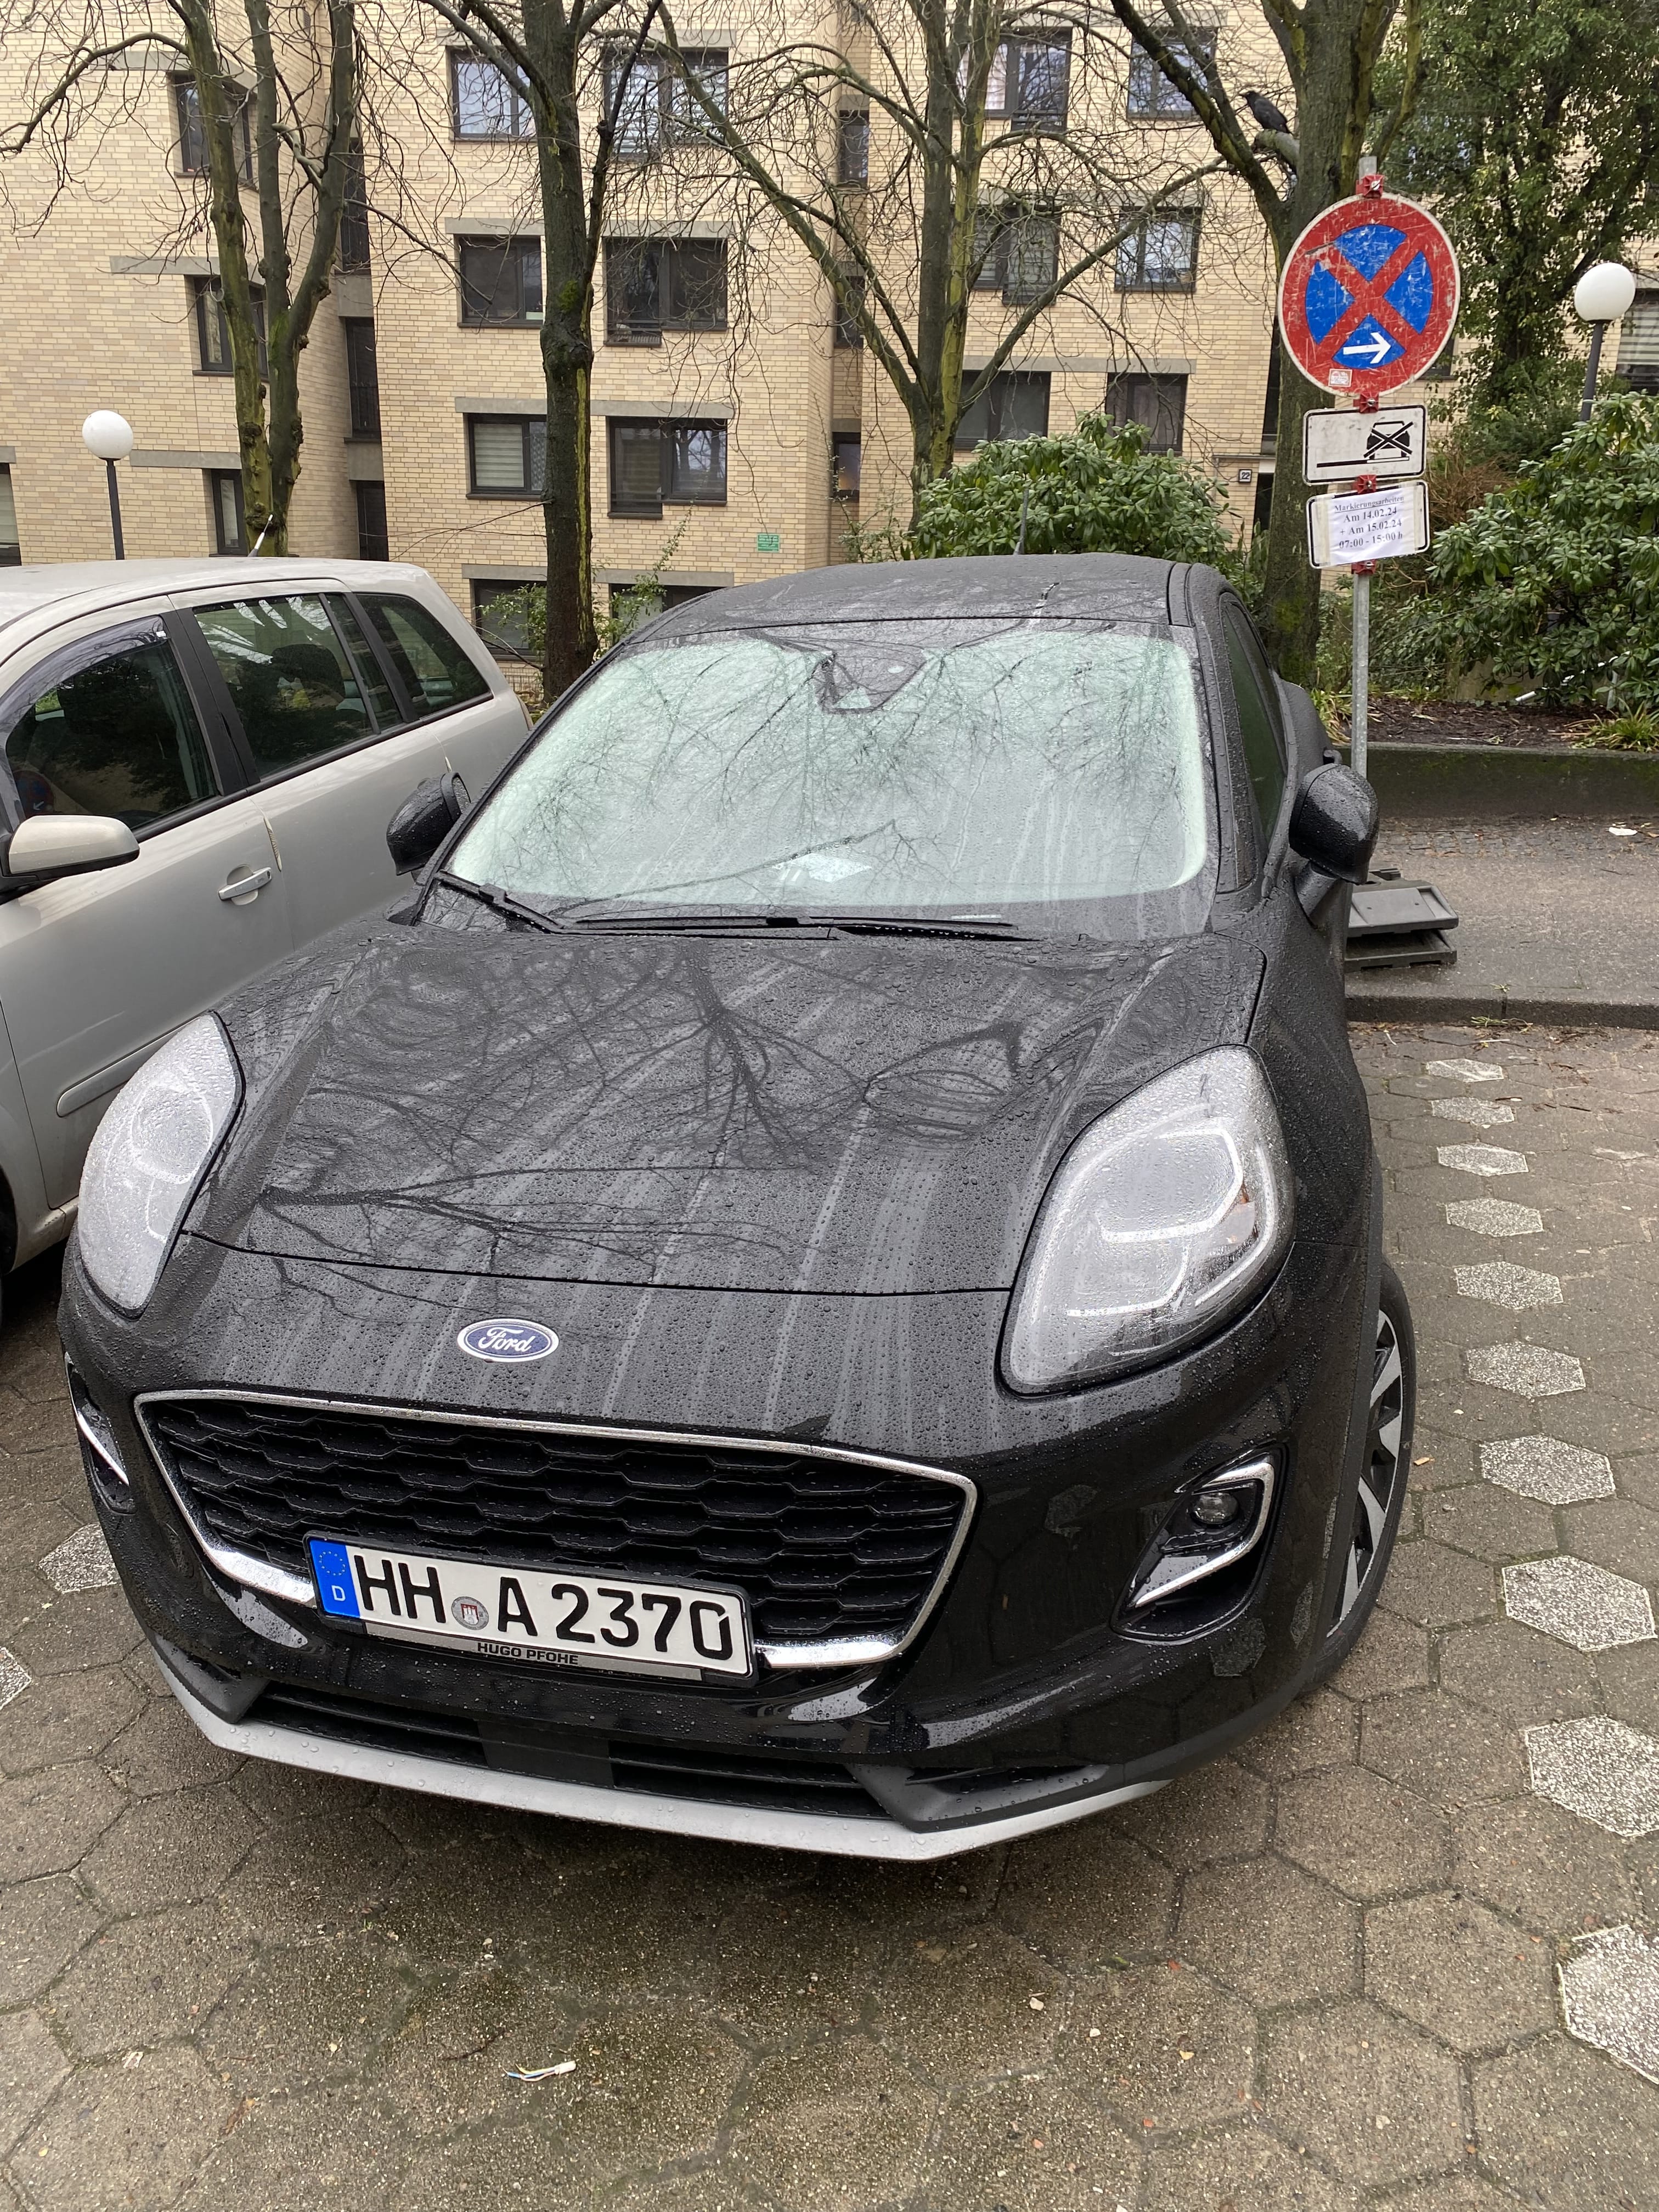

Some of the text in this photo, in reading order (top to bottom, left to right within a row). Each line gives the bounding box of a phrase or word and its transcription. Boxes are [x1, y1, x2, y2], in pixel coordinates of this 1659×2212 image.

[1334, 496, 1404, 511] Markierungsarbeiten
[1344, 506, 1397, 523] Am 14.02.24
[1368, 519, 1402, 532] 15.02.24
[1339, 538, 1363, 549] 07:00
[1372, 533, 1396, 544] 15:00
[478, 1327, 536, 1352] Ford
[333, 1585, 346, 1601] D
[353, 1554, 447, 1623] HH
[497, 1576, 538, 1636] A
[551, 1583, 734, 1661] 2370
[477, 1643, 579, 1665] HUGO PFOHE
